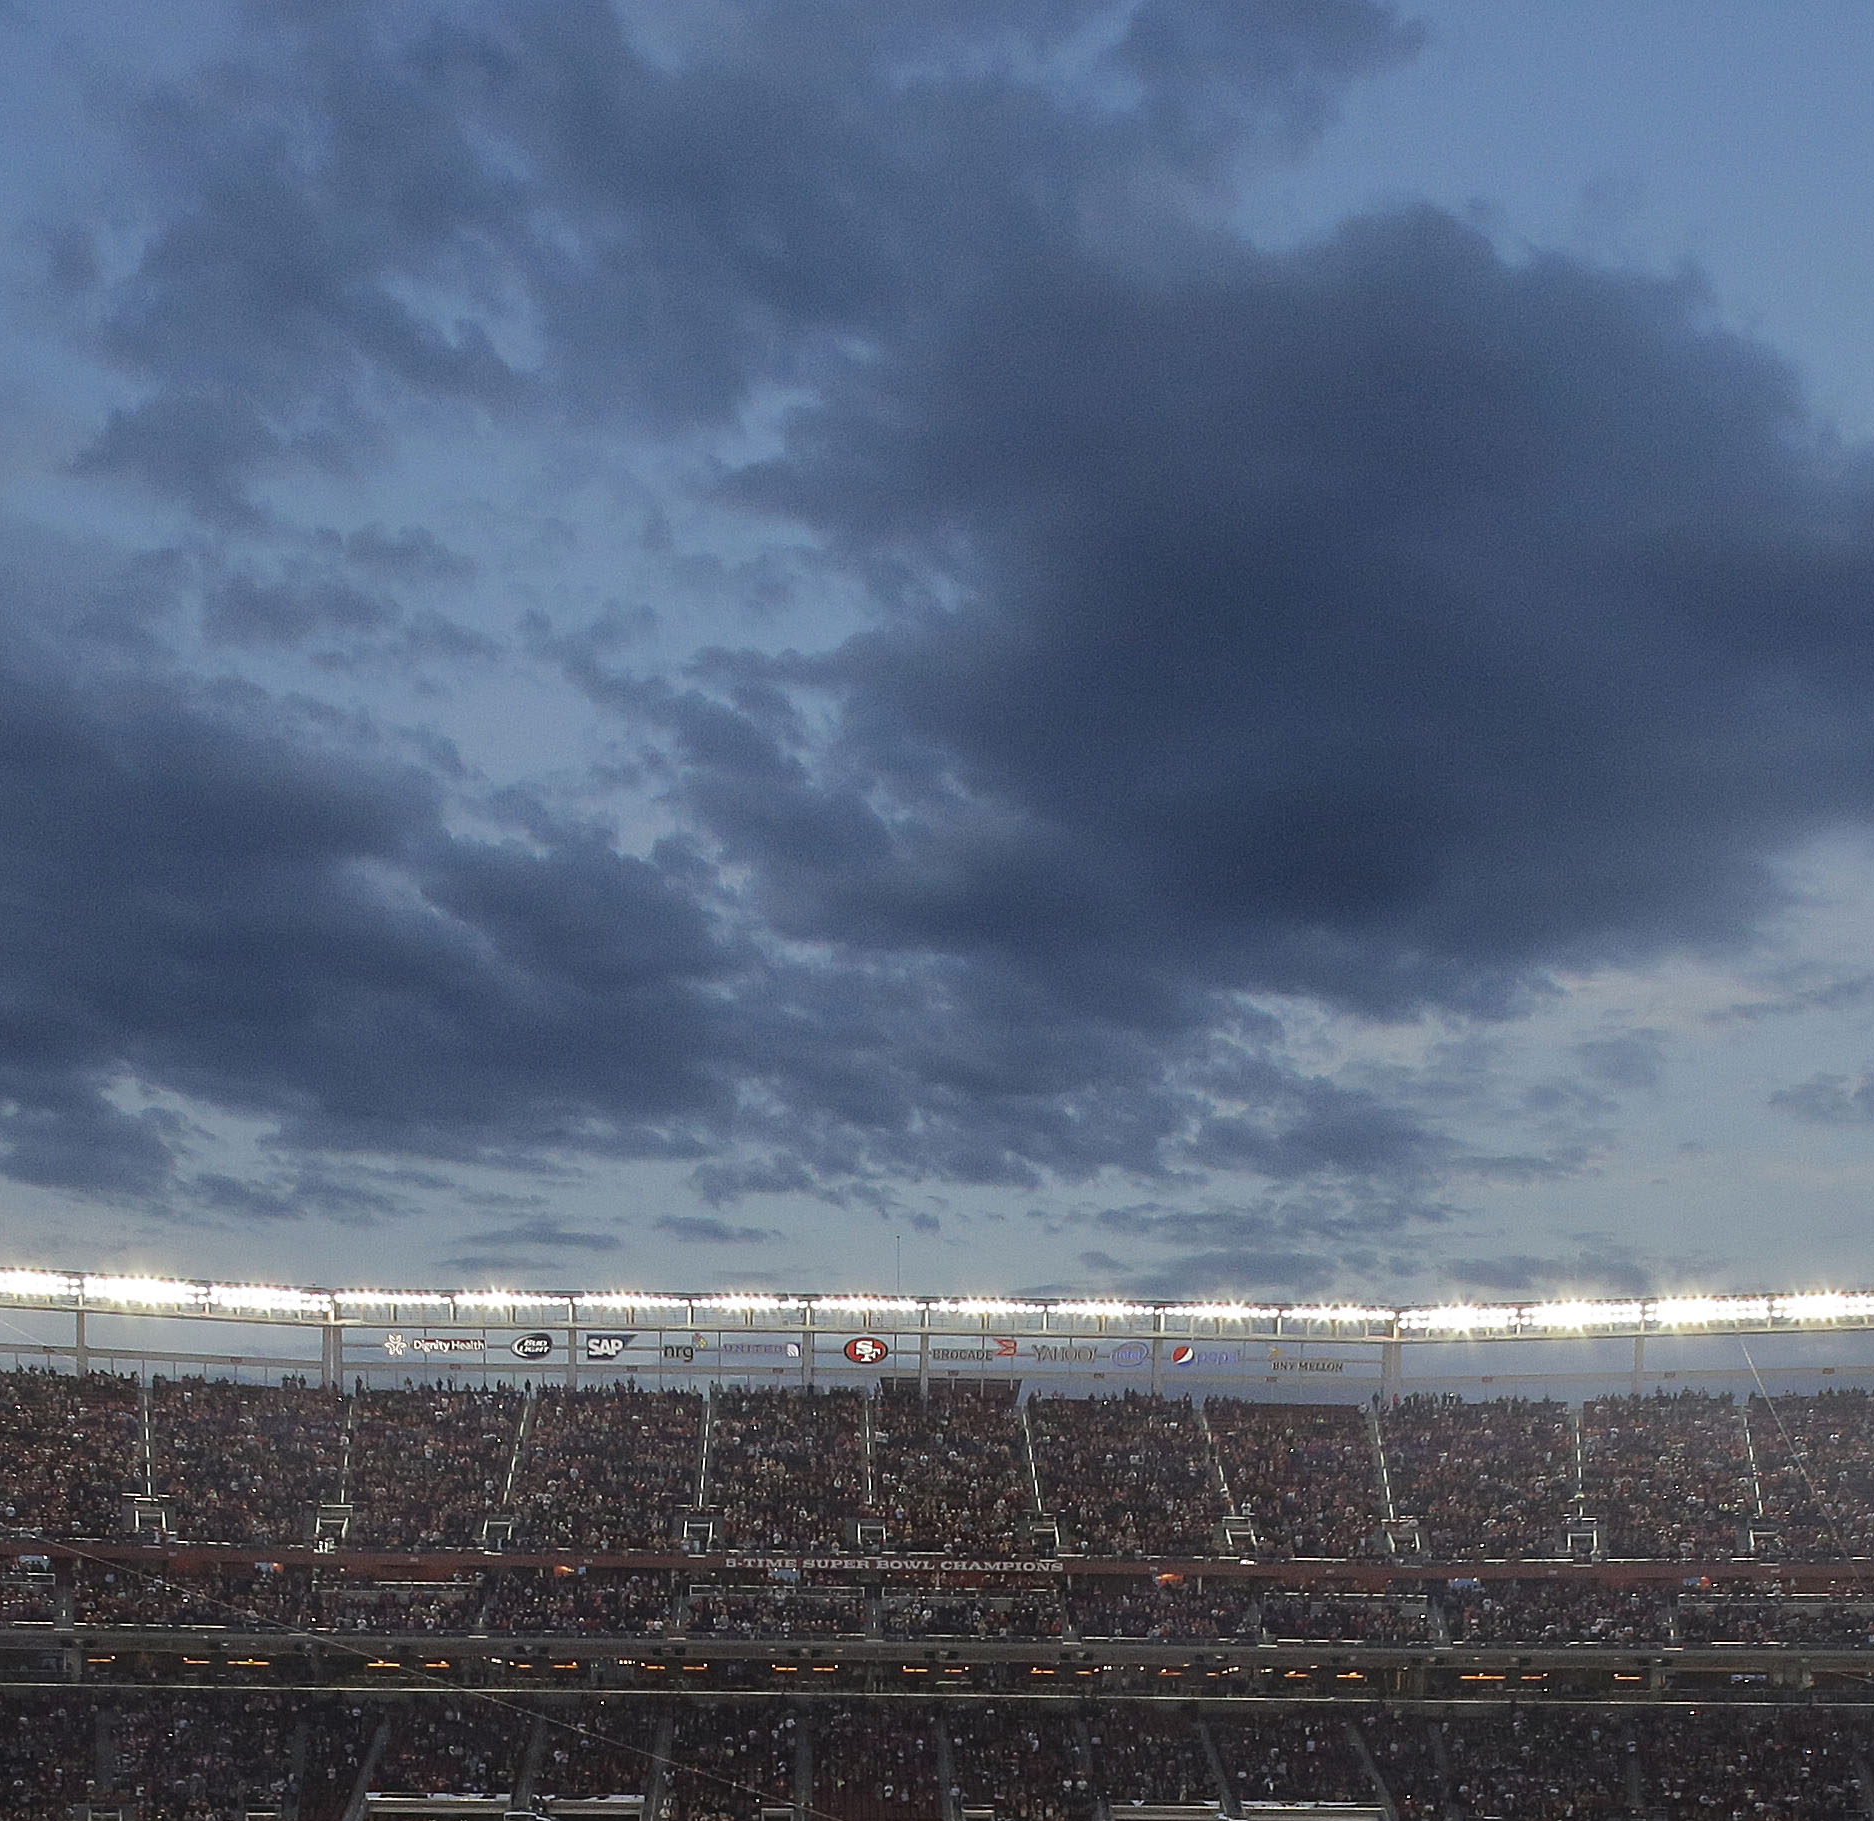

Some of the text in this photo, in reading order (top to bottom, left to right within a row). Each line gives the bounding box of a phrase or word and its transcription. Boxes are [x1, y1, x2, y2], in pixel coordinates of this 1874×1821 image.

[413, 1338, 485, 1354] Dignity Health
[523, 1339, 548, 1347] BUD
[587, 1338, 624, 1356] SAP
[722, 1343, 783, 1354] UNITED
[519, 1345, 550, 1354] LIGHT
[663, 1344, 694, 1362] nrg
[932, 1349, 994, 1361] BROCADE
[1272, 1362, 1343, 1372] BNY MELLON
[725, 1558, 1064, 1572] 5-TIME SUPER BOWL CHAMPIONS
